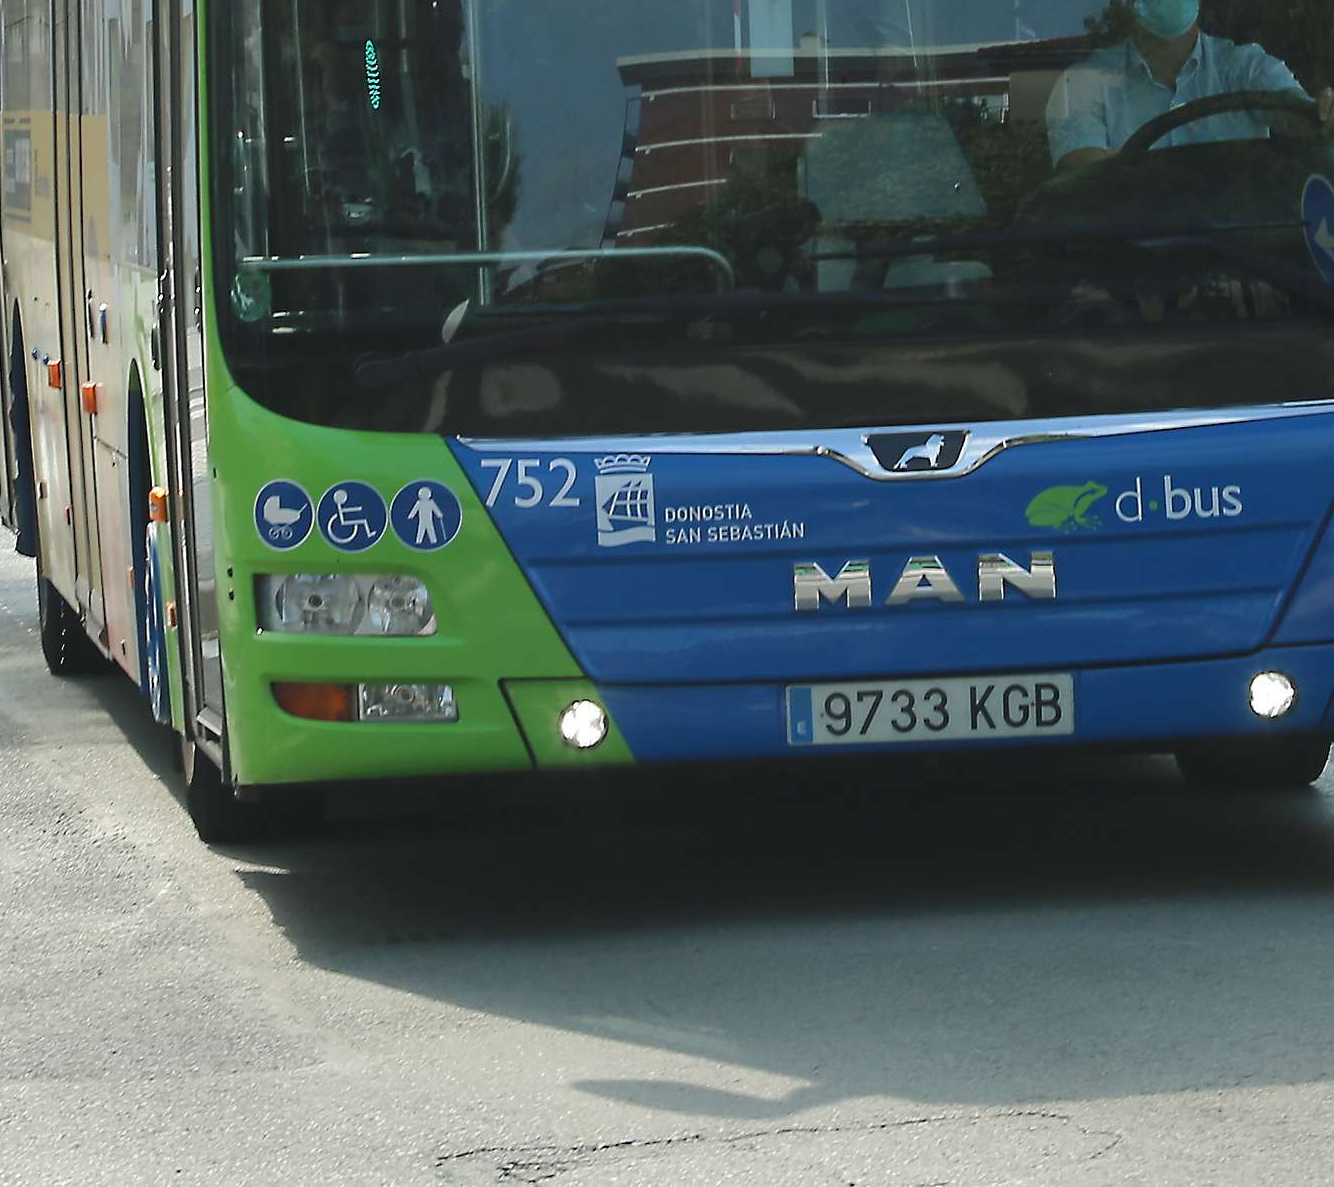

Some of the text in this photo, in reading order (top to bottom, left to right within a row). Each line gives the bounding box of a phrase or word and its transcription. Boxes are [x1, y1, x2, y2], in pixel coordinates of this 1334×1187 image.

[481, 459, 580, 508] 752
[665, 504, 752, 523] DONOSTIA
[666, 520, 804, 544] SAN SEBASTIÁN
[794, 551, 1056, 610] MAN
[823, 683, 1063, 736] 9733 KGB
